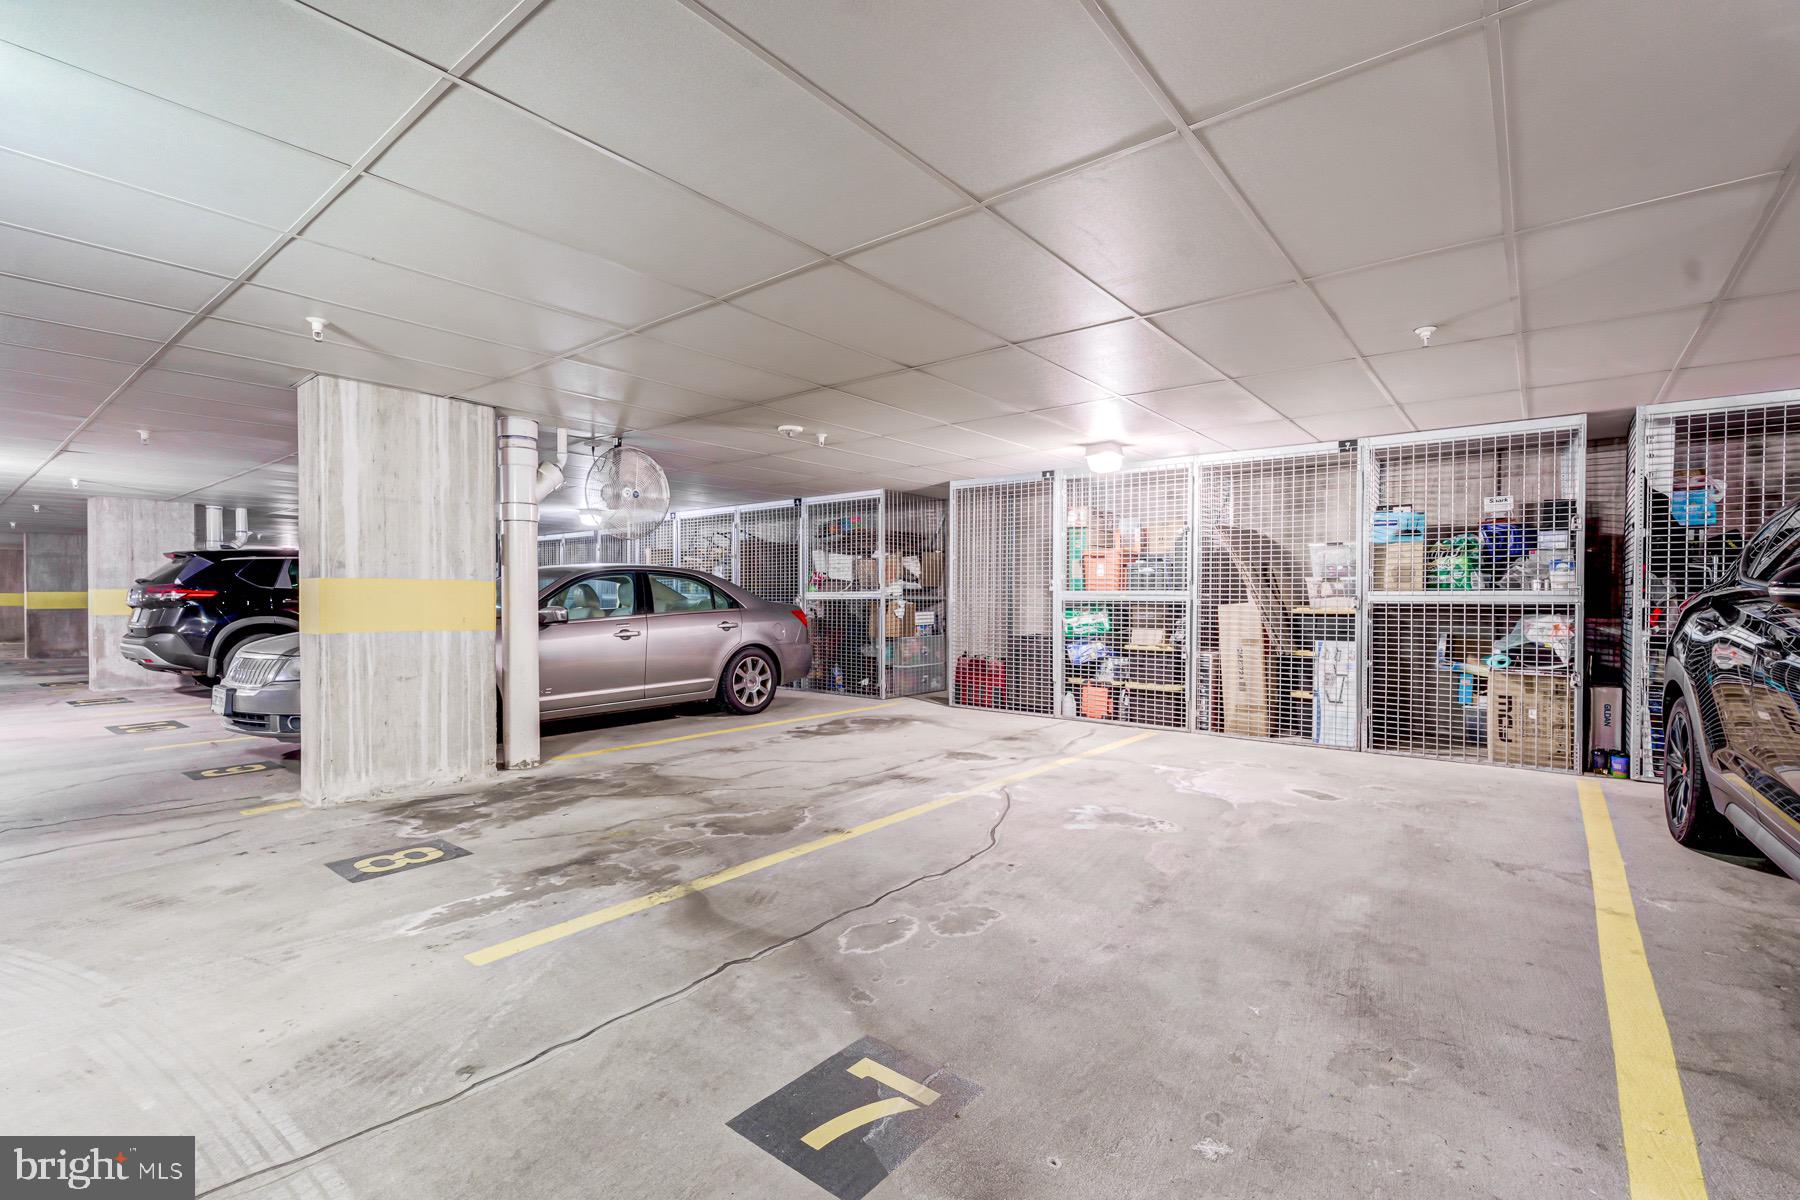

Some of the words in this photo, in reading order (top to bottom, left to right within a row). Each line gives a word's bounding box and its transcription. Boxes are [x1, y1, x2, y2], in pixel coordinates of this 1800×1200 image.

[200, 764, 267, 778] 9
[353, 846, 445, 873] 8
[800, 1057, 943, 1151] 7
